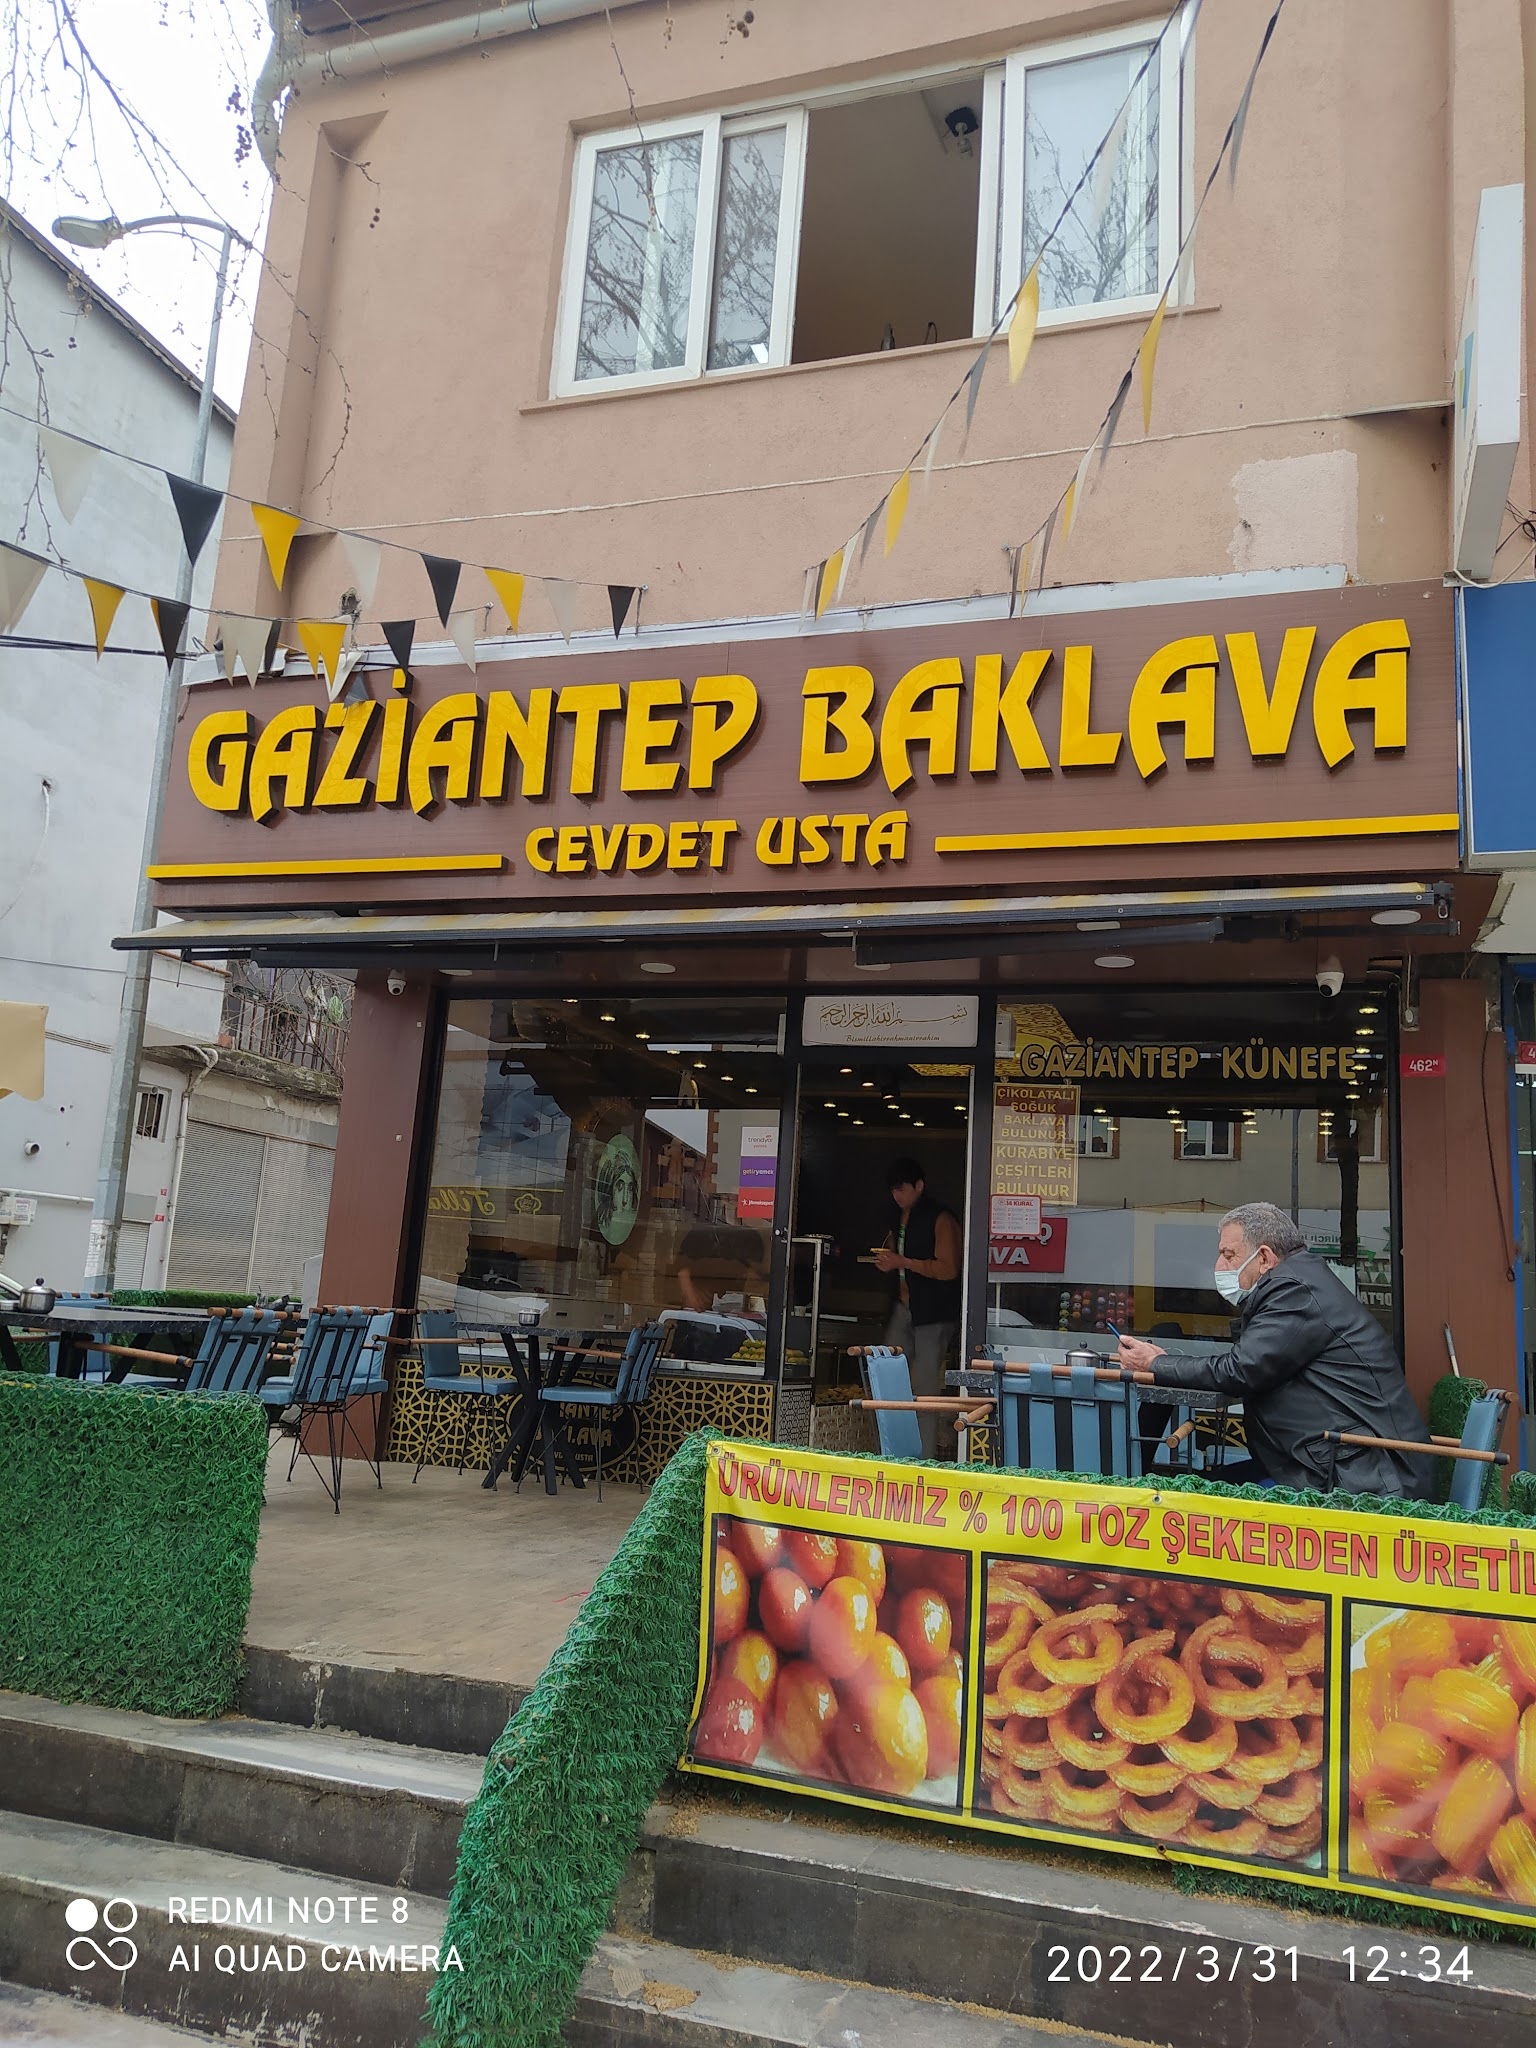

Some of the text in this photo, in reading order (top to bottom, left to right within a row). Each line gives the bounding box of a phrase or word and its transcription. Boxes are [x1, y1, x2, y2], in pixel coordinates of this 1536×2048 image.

[187, 619, 1411, 822] GAZİANTEP BAKLAVA
[525, 810, 908, 873] CEVDET USTA
[1020, 1037, 1357, 1080] GAZİANTEP KÜNEFE
[997, 1087, 1075, 1101] ÇİKOLATALI
[1011, 1101, 1057, 1113] SOĞUK
[1004, 1114, 1066, 1127] BAKLAVA
[1001, 1128, 1067, 1140] BULUNUR
[996, 1145, 1073, 1161] KURABİYE
[995, 1163, 1073, 1180] ÇEŞİTLERİ
[996, 1182, 1070, 1198] BULUNUR
[718, 1452, 949, 1527] ÜRÜNLERİMİZ
[959, 1489, 988, 1534] %
[1001, 1495, 1064, 1541] 100
[1075, 1502, 1151, 1550] TOZ
[1161, 1511, 1378, 1579] ŞEKERDEN
